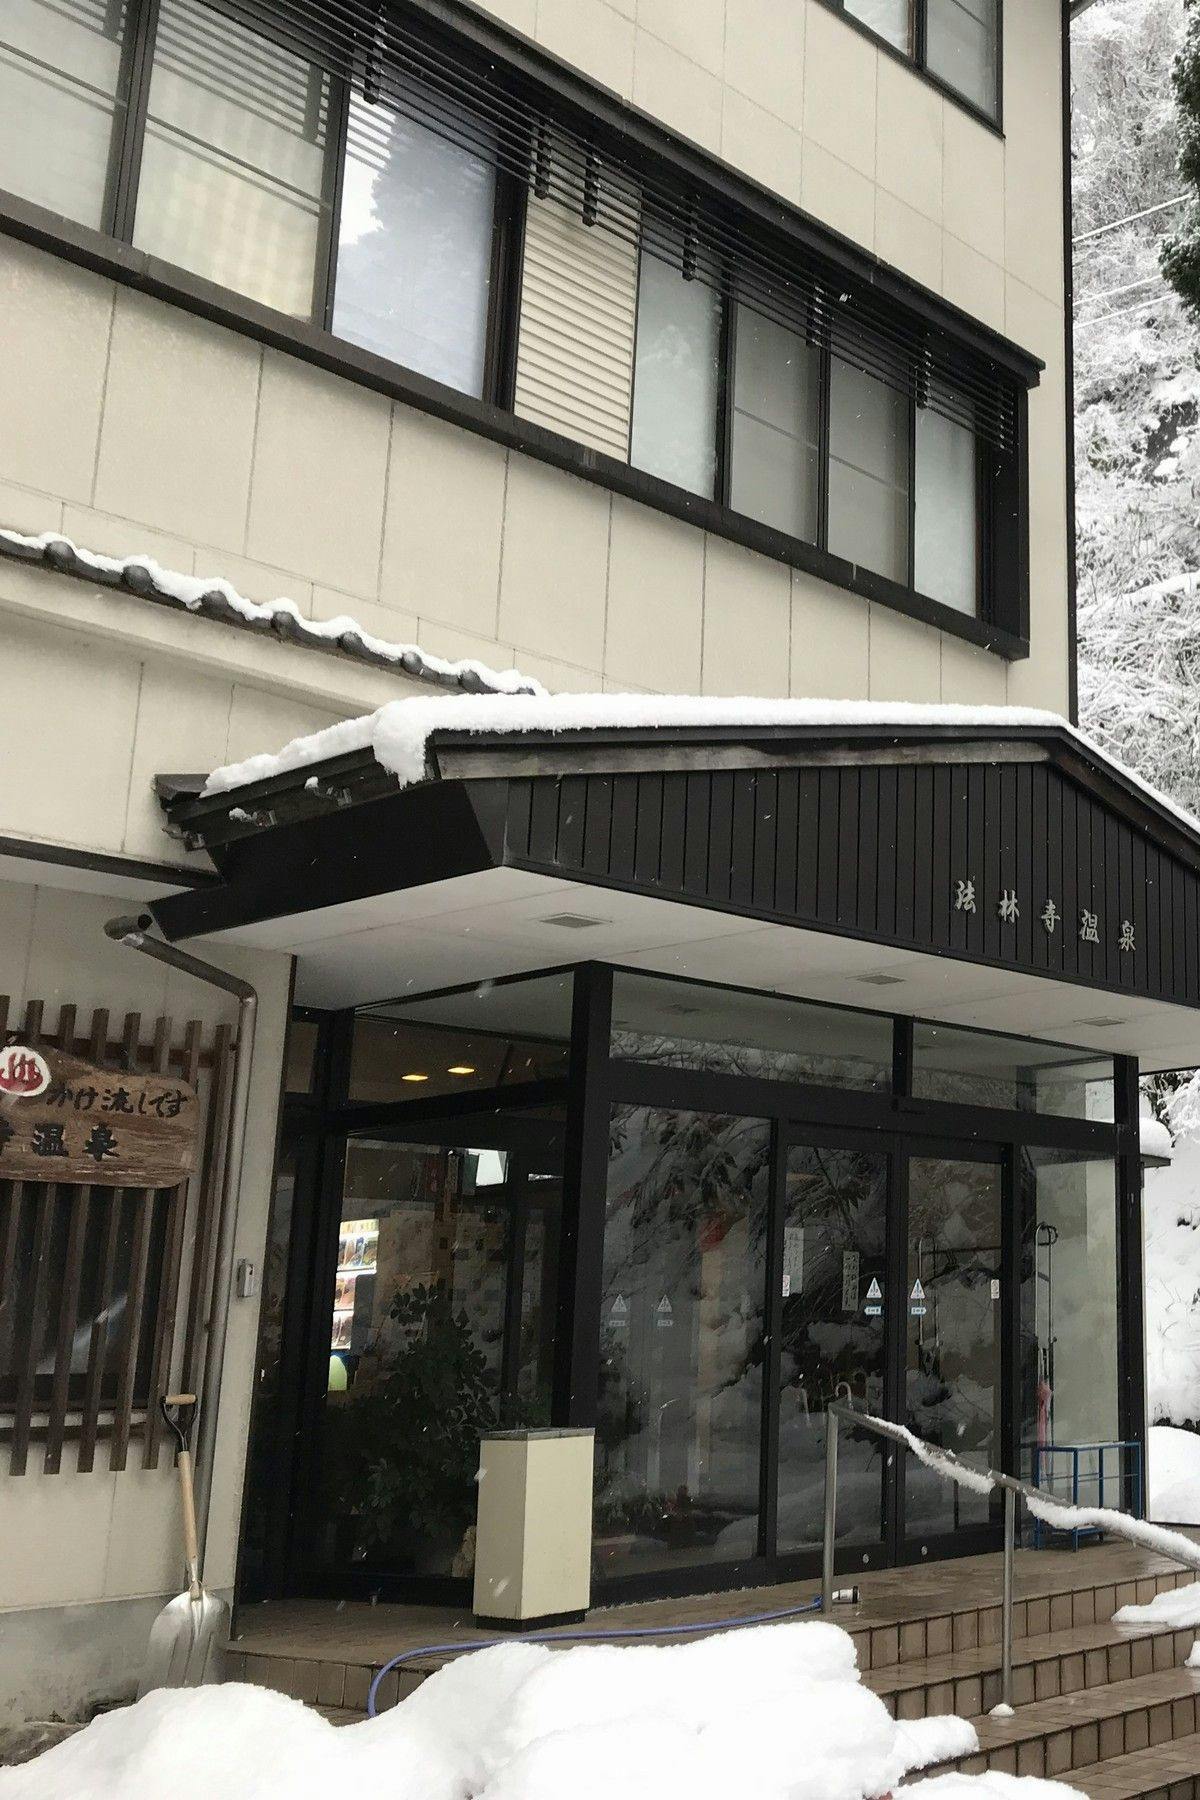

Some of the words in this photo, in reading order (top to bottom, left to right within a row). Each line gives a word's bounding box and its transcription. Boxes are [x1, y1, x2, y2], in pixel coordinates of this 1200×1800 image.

[955, 880, 1136, 952] 法林寺温泉
